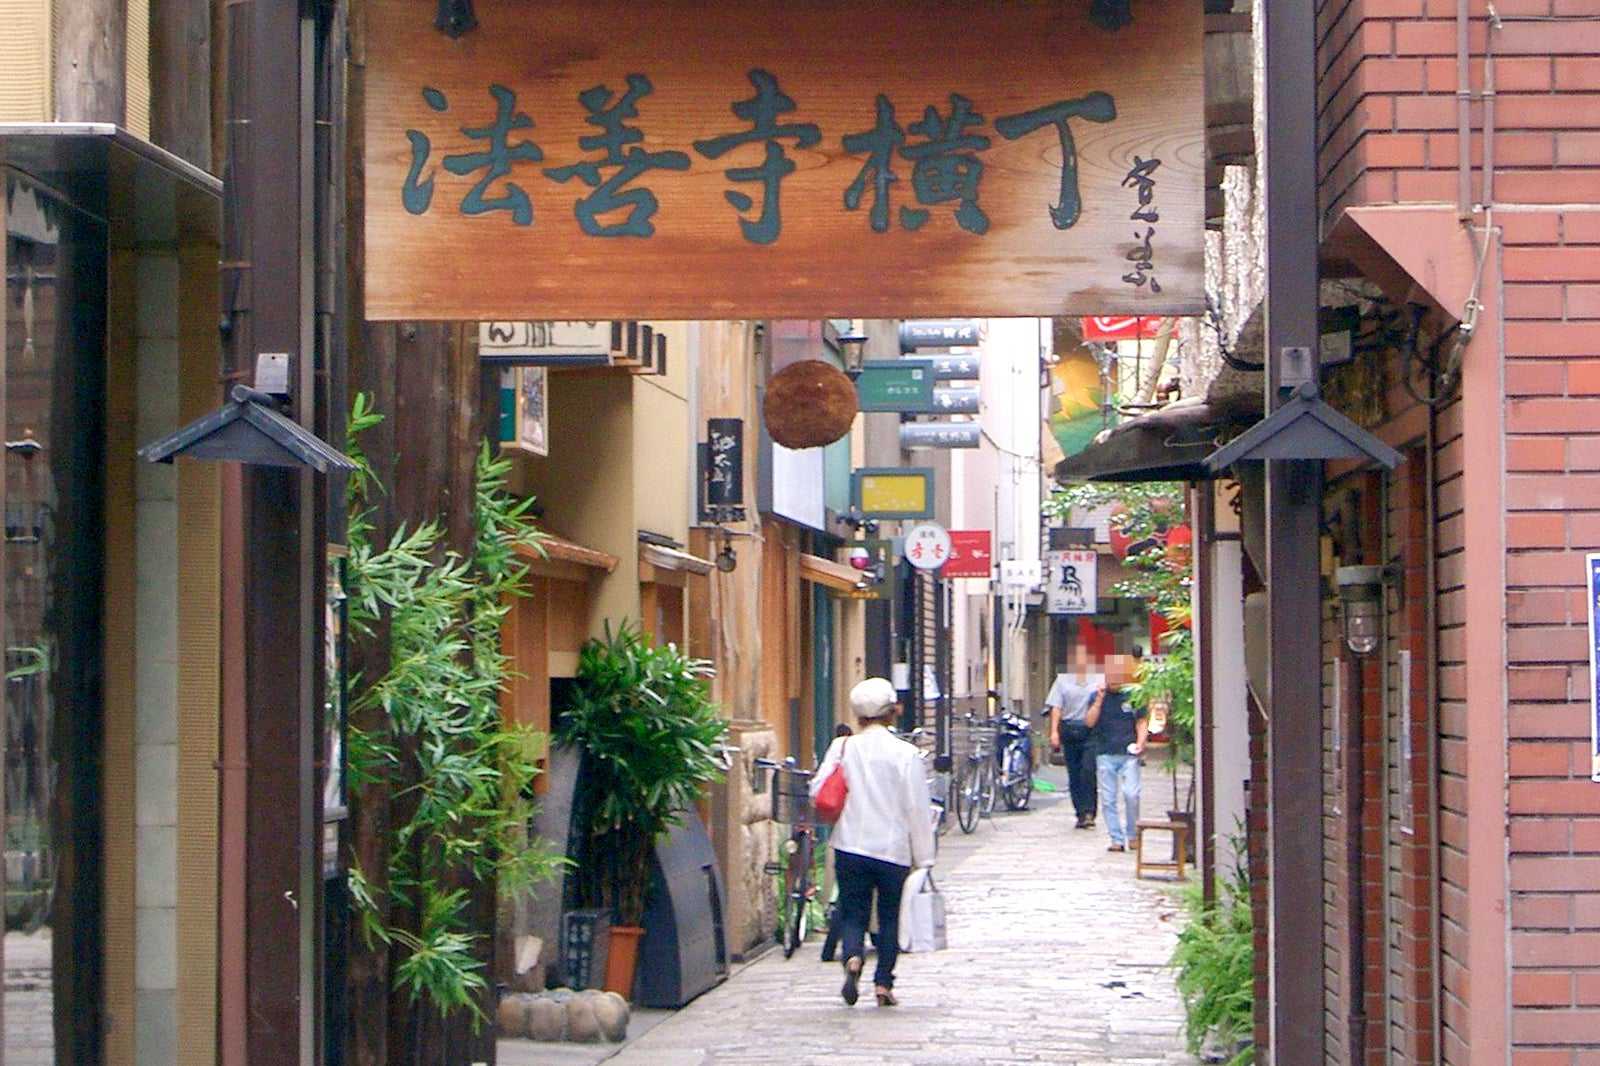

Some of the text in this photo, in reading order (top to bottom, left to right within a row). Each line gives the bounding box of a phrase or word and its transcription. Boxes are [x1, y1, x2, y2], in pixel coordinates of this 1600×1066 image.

[401, 68, 1117, 245] 法善寺横丁
